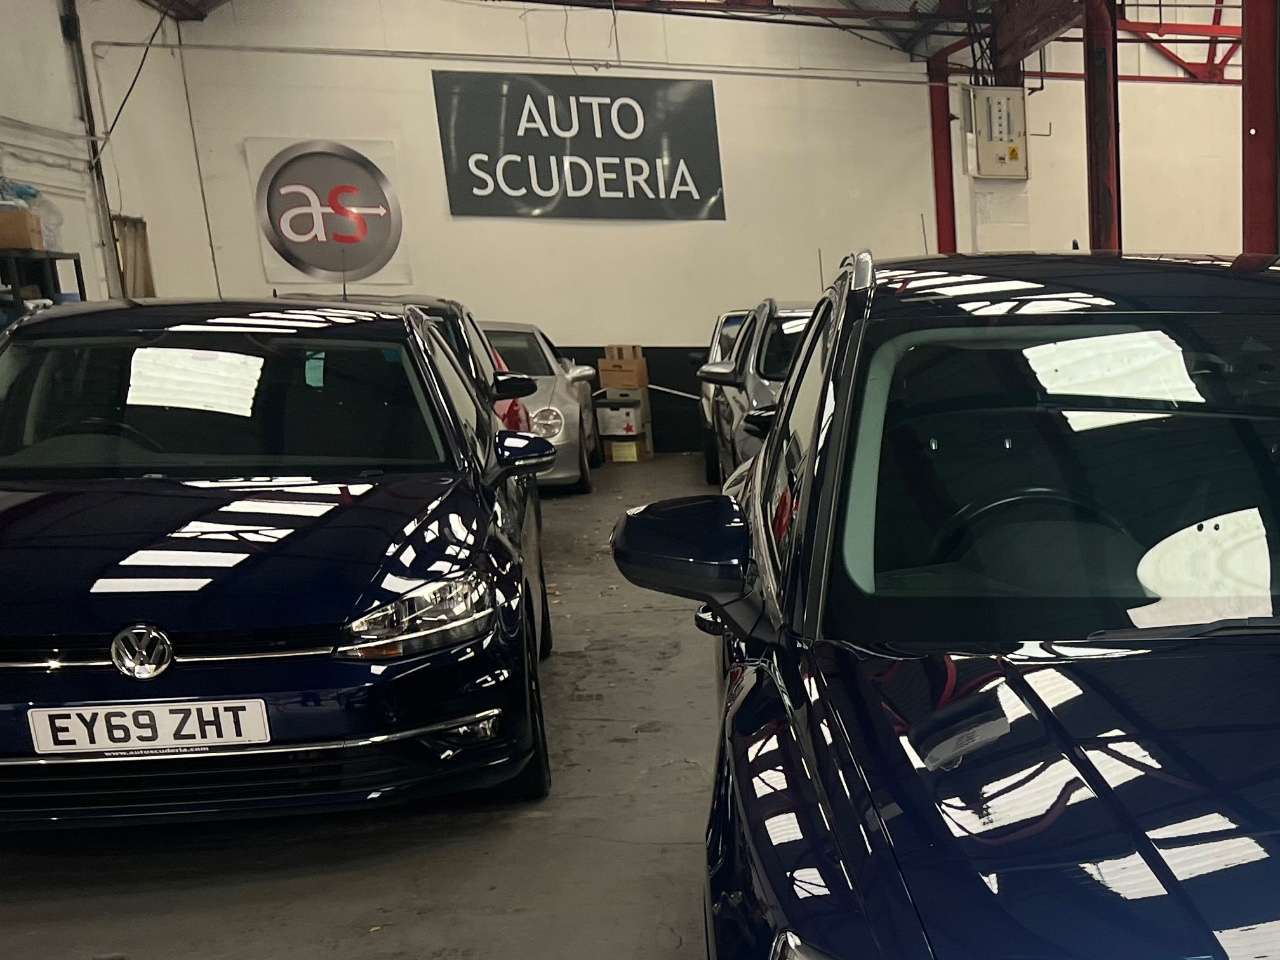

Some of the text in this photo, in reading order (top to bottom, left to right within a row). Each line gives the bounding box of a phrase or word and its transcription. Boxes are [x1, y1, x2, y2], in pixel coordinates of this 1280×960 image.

[517, 94, 645, 140] AUTO
[468, 153, 701, 200] SCUDERIA
[278, 184, 369, 244] as
[47, 705, 247, 746] EY69 ZHT
[104, 746, 209, 757] www.autoscuderia.com
